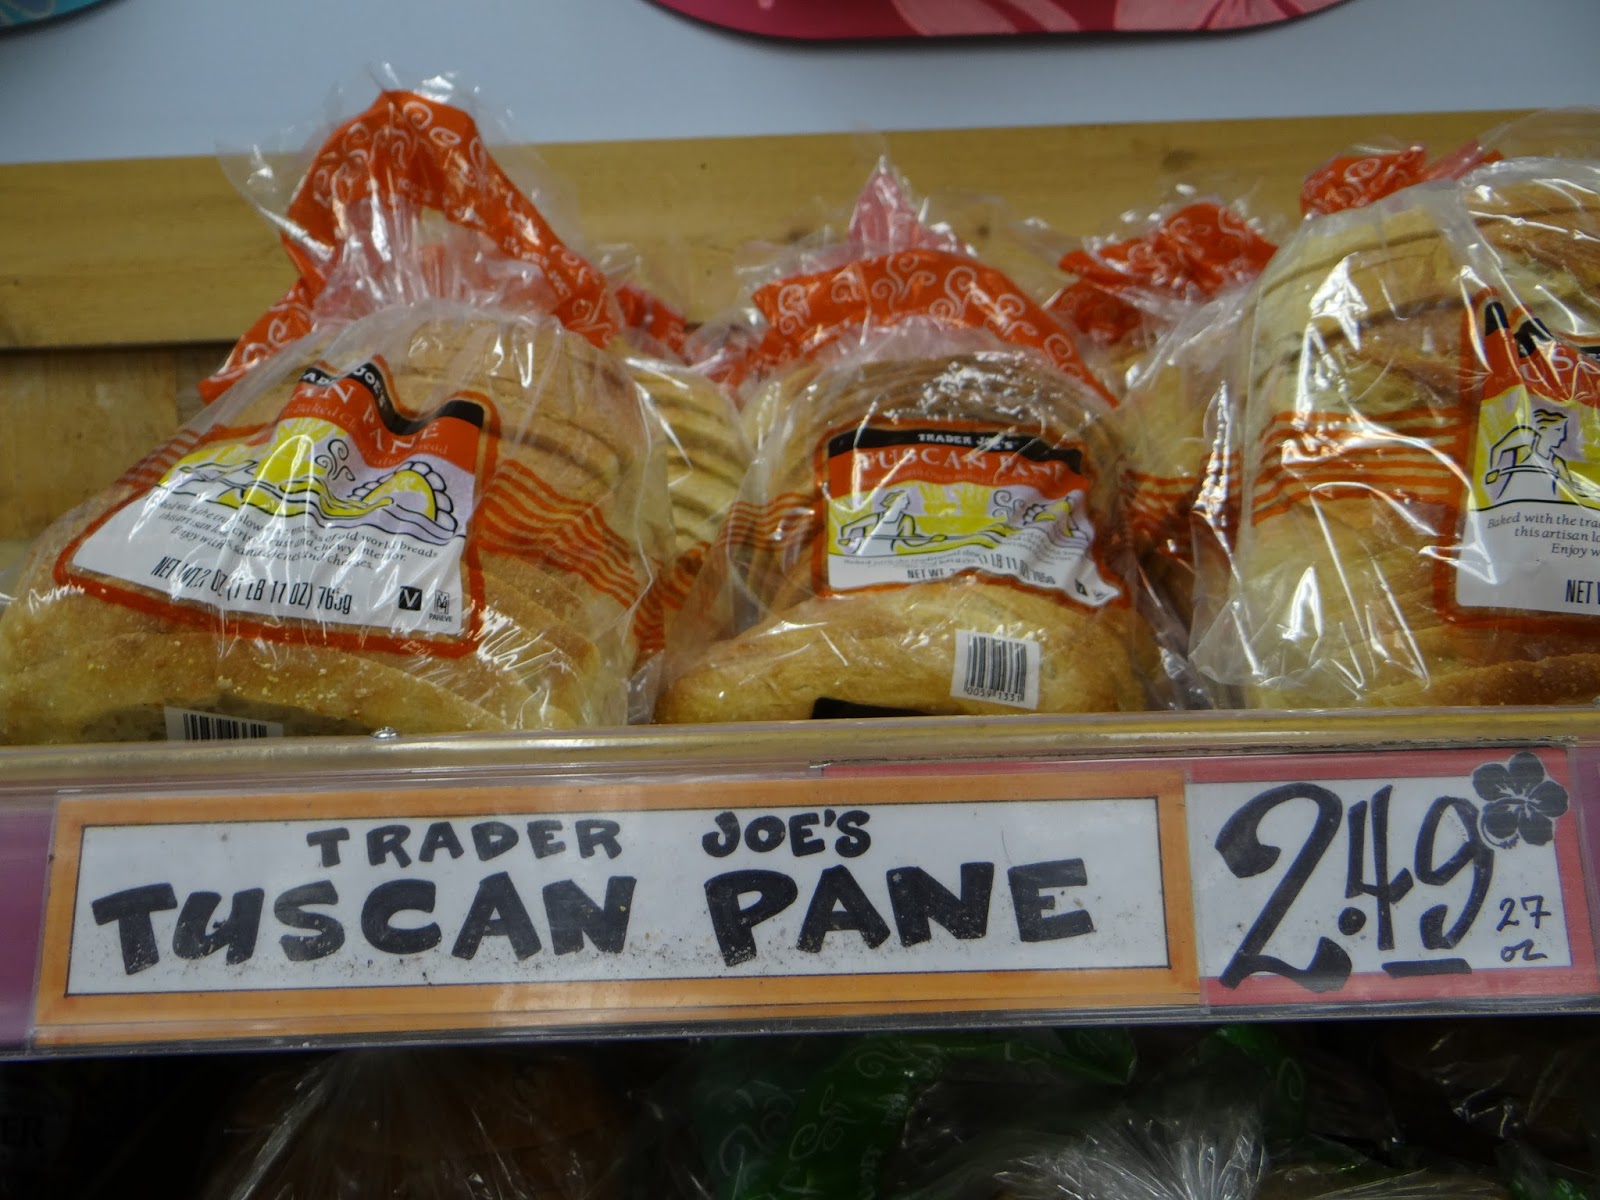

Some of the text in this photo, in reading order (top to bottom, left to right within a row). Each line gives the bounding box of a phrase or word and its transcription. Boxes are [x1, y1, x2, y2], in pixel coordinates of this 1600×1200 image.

[917, 433, 972, 445] TRADER
[1487, 511, 1521, 529] Baked
[1523, 512, 1554, 525] with
[1556, 513, 1577, 526] the
[1514, 525, 1540, 538] this
[1541, 529, 1589, 541] artisan
[400, 540, 439, 558] breads
[1551, 543, 1588, 558] Enjoy
[151, 556, 181, 580] NET
[245, 578, 265, 601] LB
[288, 581, 313, 609] OZ)
[906, 569, 925, 579] NET
[1564, 579, 1594, 605] NET
[306, 808, 872, 868] TRADER JOE'S
[1214, 782, 1495, 993] 2.49
[91, 857, 1097, 976] TUSCAN PANE
[1496, 894, 1552, 932] 27
